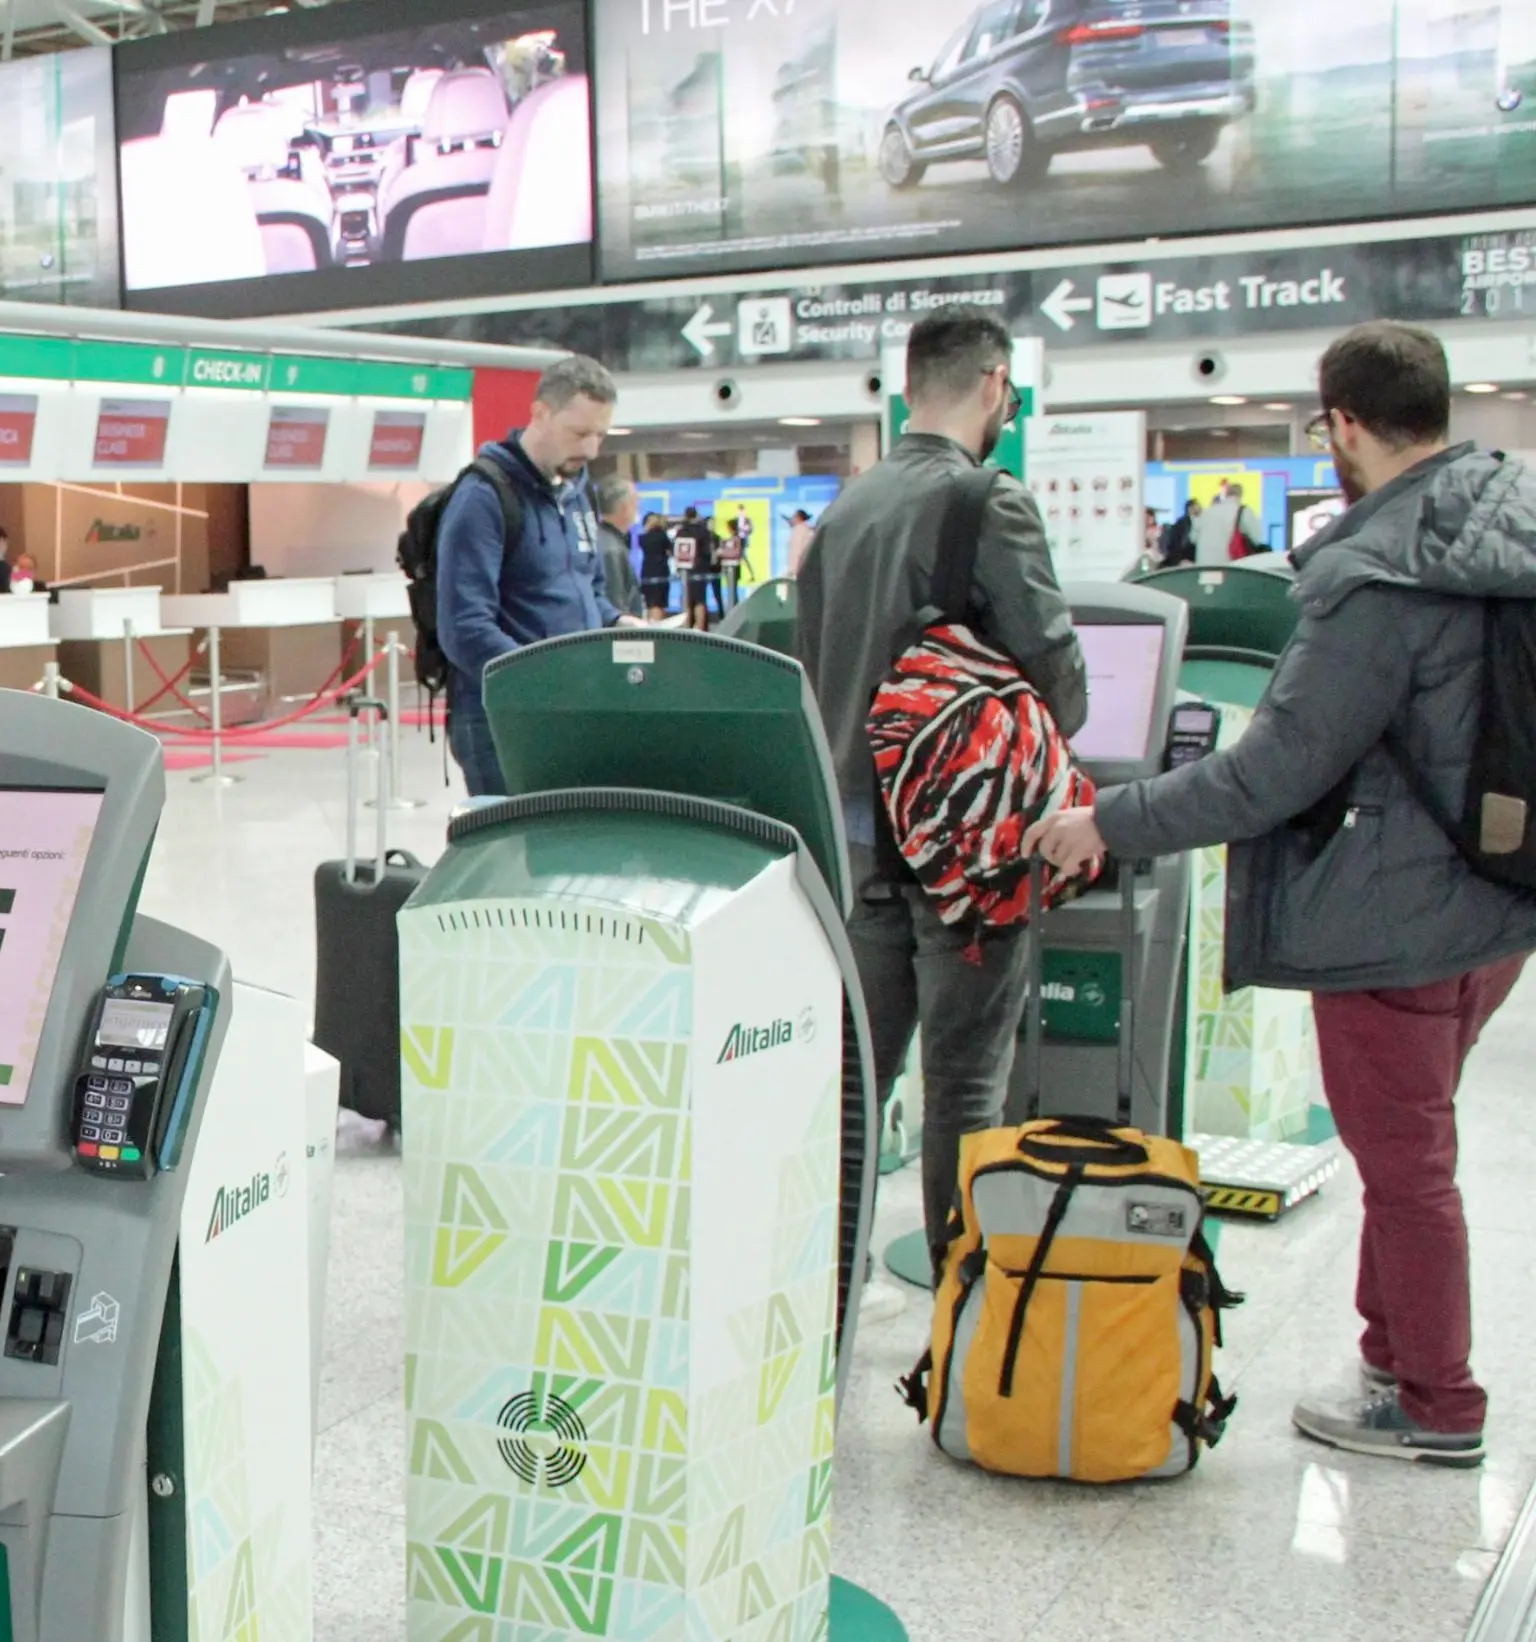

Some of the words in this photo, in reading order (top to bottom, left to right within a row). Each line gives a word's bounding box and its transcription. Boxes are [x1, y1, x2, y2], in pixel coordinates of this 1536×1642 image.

[796, 293, 881, 318] Controlli
[885, 291, 906, 312] di
[910, 289, 1005, 310] Sicurezza
[1155, 281, 1230, 315] Fast
[1239, 268, 1346, 309] Track
[798, 320, 876, 344] Security
[152, 355, 165, 378] 8
[194, 358, 261, 383] CHECK-IN
[85, 517, 142, 544] Alitalia
[716, 1019, 793, 1065] Alitalia
[204, 1172, 270, 1244] Alitalia
